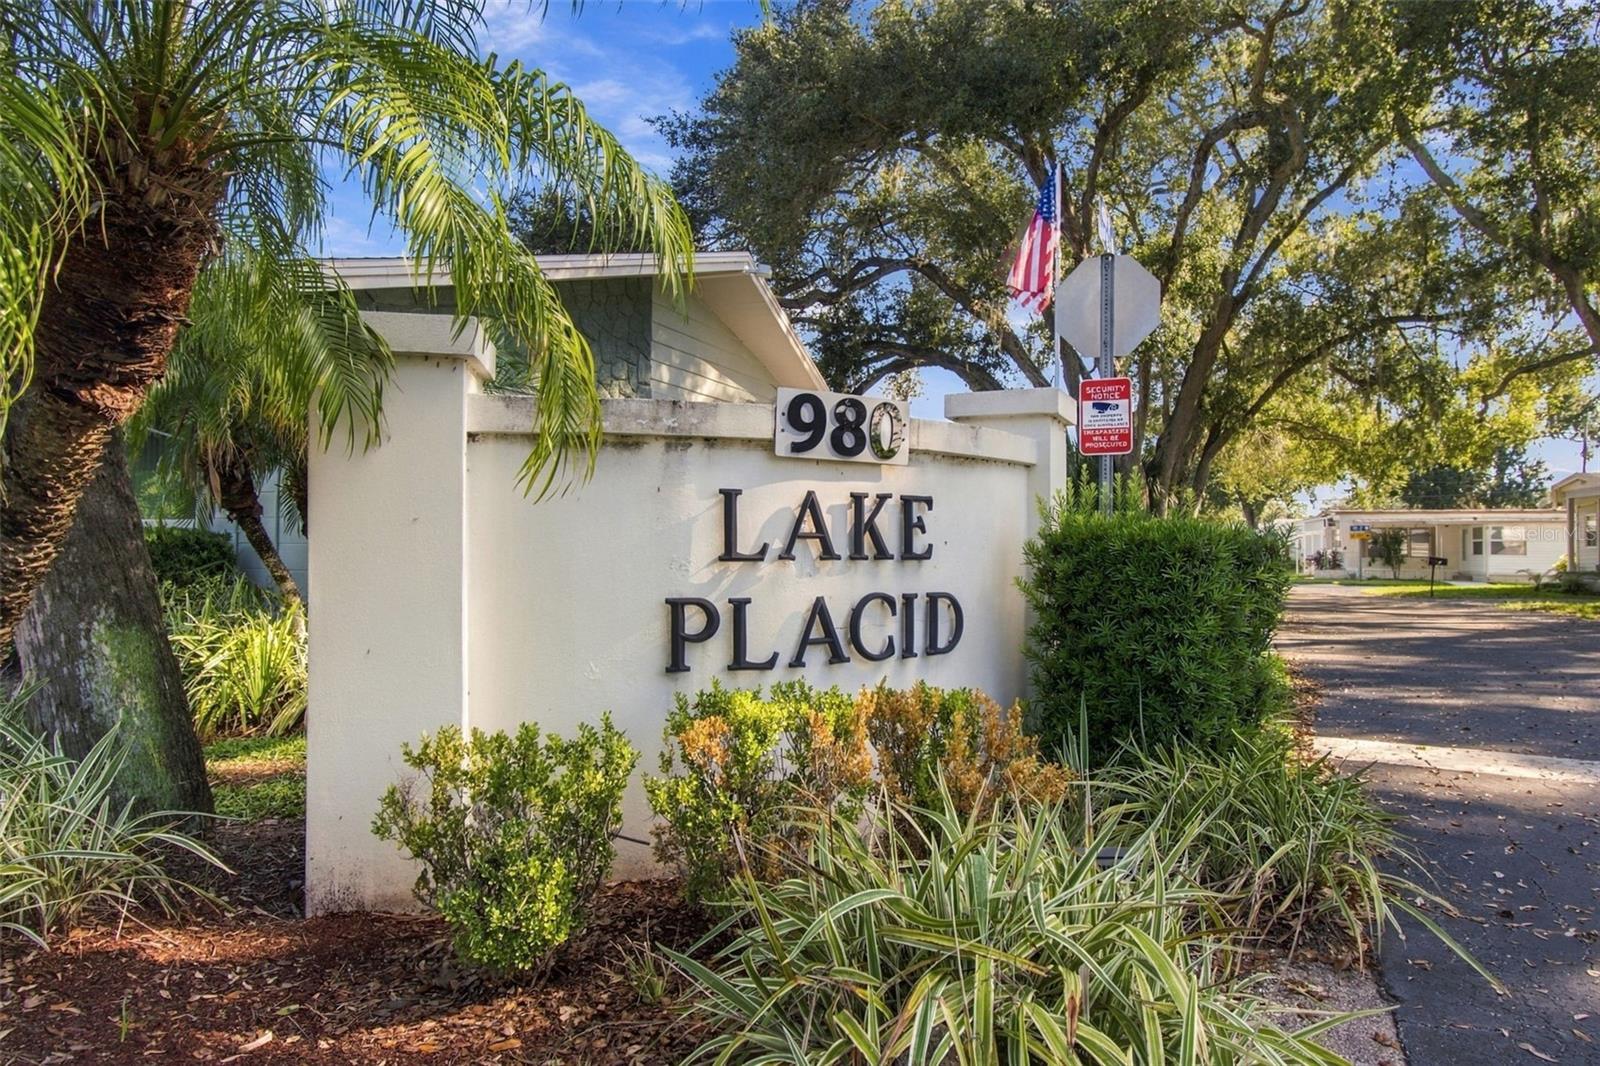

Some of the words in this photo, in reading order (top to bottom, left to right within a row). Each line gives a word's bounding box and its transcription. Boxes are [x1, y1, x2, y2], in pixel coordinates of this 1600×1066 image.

[1086, 385, 1126, 394] SECURITY
[1091, 392, 1120, 400] NOTICE
[787, 393, 903, 460] 980
[1085, 441, 1128, 449] PROSECUTED
[718, 488, 933, 562] LAKE
[665, 592, 964, 673] PLACID
